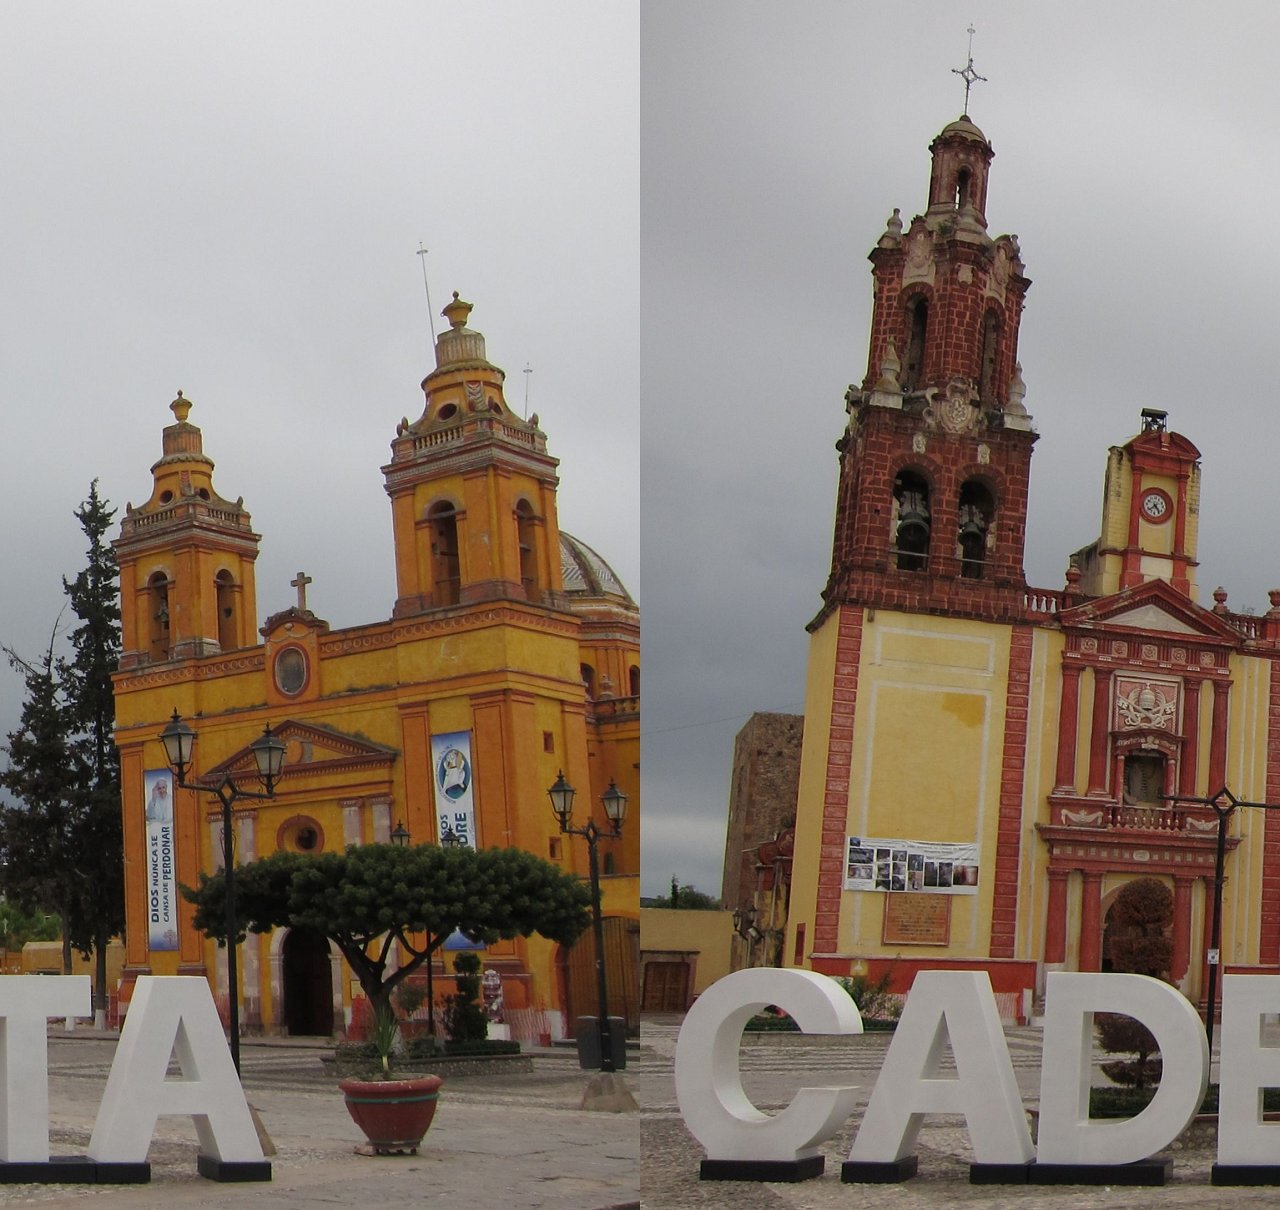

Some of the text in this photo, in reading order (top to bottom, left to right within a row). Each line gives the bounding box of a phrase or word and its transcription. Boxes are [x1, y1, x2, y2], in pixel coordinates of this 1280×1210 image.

[151, 835, 158, 846] SE
[455, 812, 468, 845] DRE
[162, 826, 171, 880] PERDONAR
[163, 882, 169, 893] DE
[151, 889, 160, 923] DIOS
